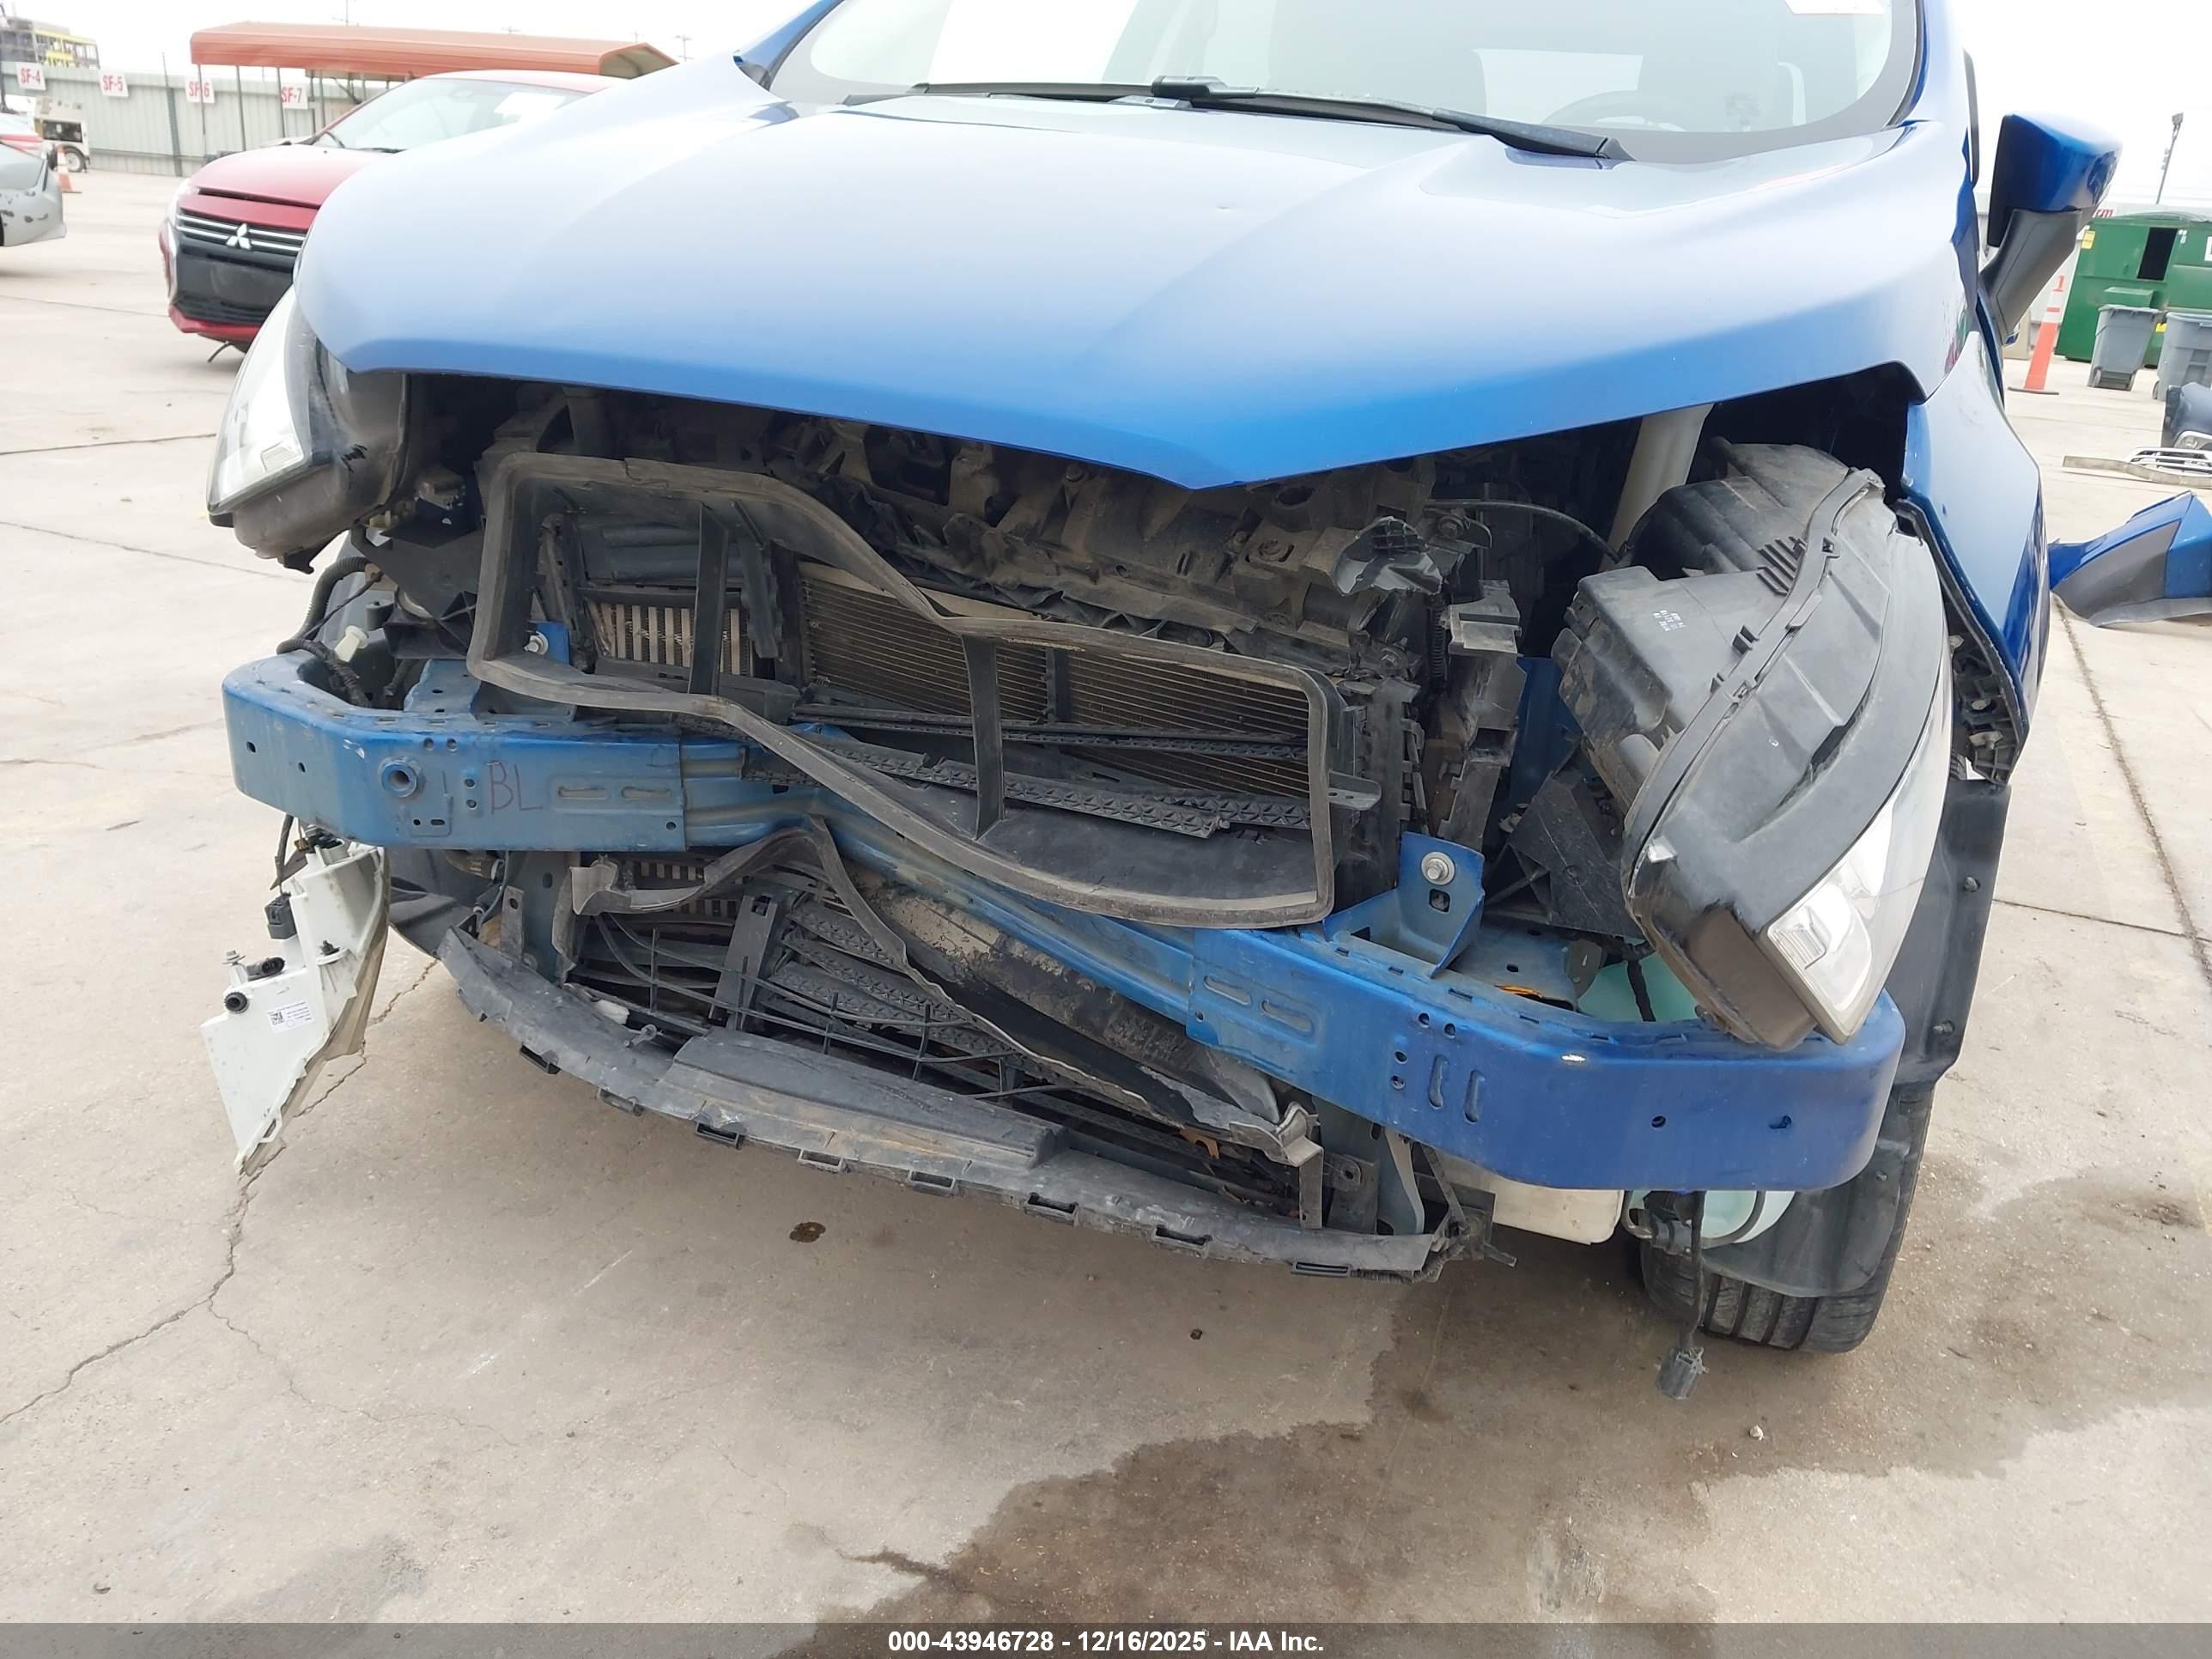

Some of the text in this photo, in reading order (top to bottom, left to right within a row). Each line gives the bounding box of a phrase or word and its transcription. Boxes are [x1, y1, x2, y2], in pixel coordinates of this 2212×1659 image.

[20, 68, 41, 84] SF-4
[102, 75, 124, 92] SF-5
[188, 81, 210, 98] SF6
[281, 86, 302, 103] SF-7
[489, 759, 544, 815] BL
